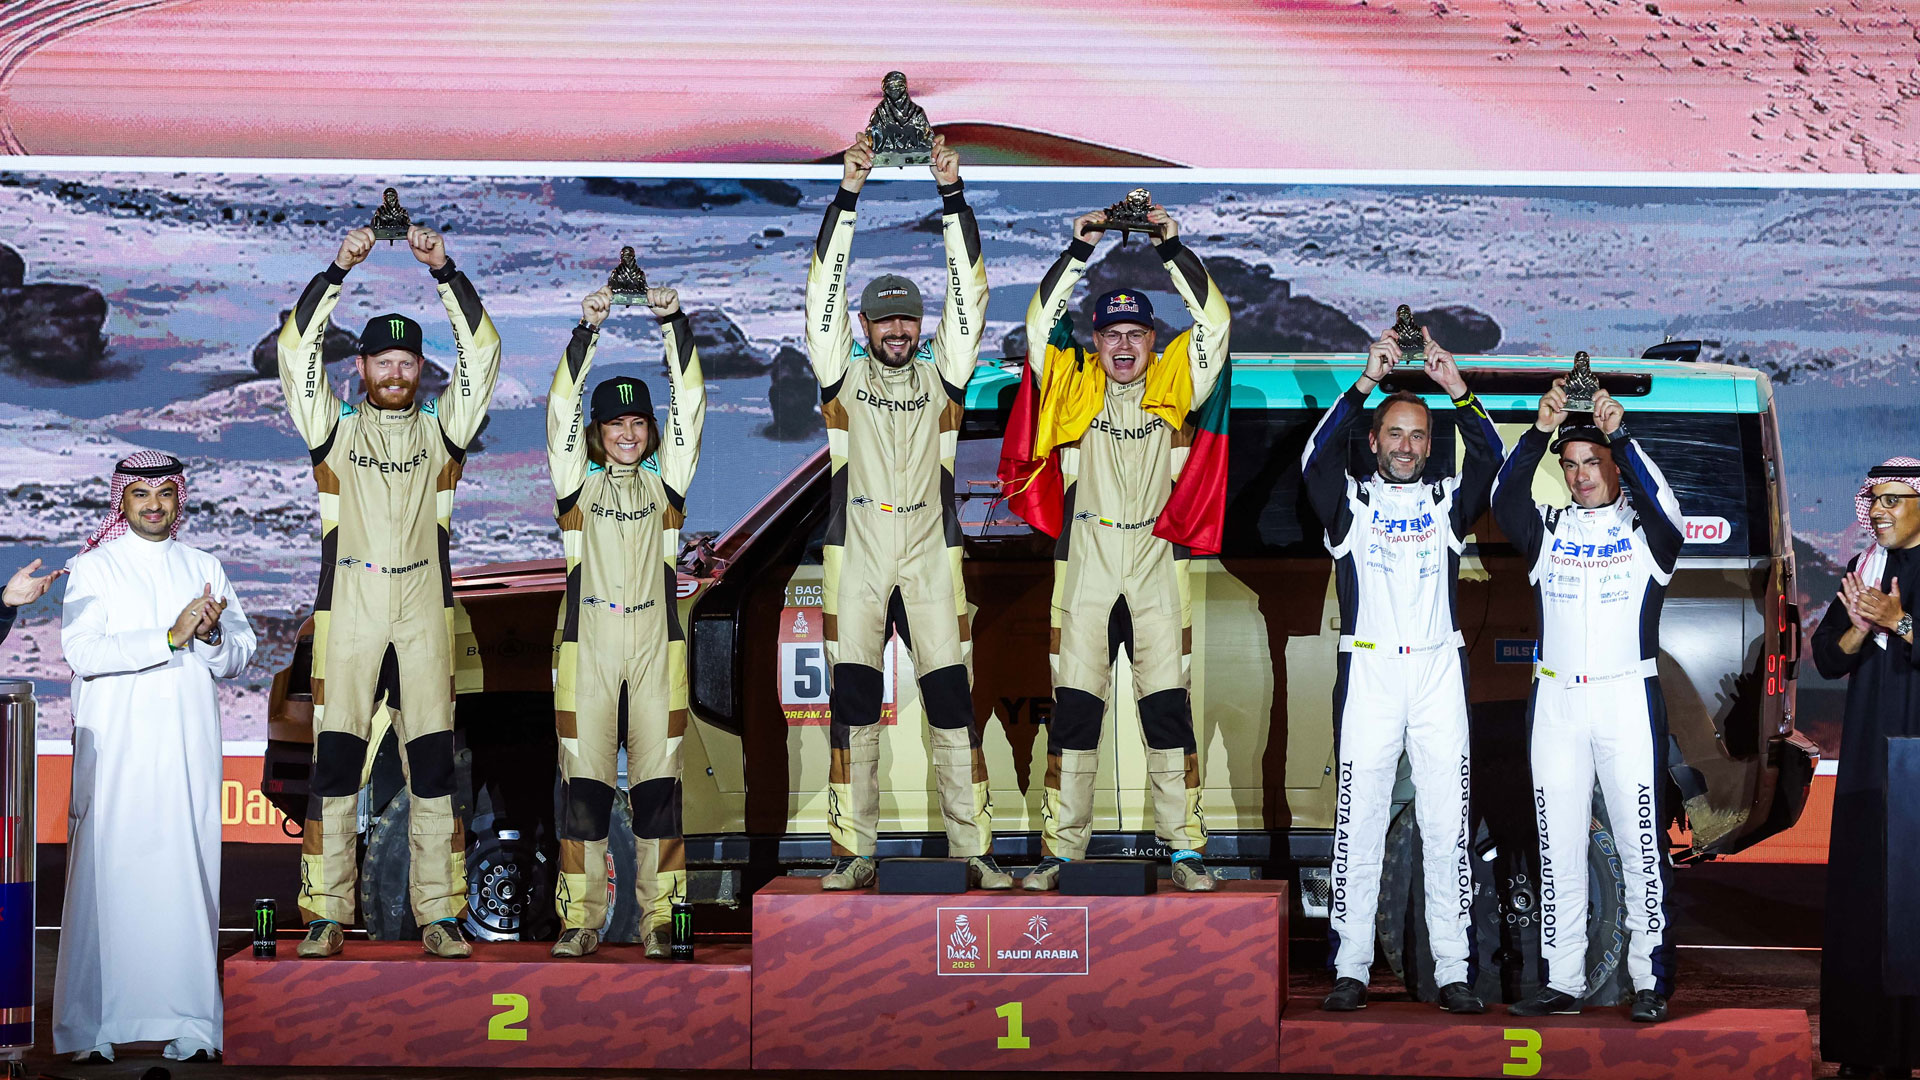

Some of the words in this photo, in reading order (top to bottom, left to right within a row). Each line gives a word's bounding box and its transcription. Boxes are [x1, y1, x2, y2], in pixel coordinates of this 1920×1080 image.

[820, 253, 845, 332] DEFENDER
[949, 257, 969, 335] DEFENDER
[1107, 305, 1121, 313] Red
[1123, 303, 1139, 312] Bull
[857, 389, 931, 411] DEFENDER
[1090, 418, 1164, 440] DEFENDER
[349, 448, 429, 473] DEFENDER
[590, 502, 656, 521] DEFENDER
[897, 501, 927, 513] O.VIDAL
[1686, 521, 1723, 539] trol
[391, 558, 428, 574] BERRIMAN
[625, 599, 655, 614] S.PRICE
[795, 596, 823, 605] VIDA
[1338, 760, 1353, 825] TOYOTA
[1460, 754, 1469, 801] BODY
[1535, 786, 1549, 851] TOYOTA
[1637, 783, 1650, 829] BODY
[1122, 848, 1168, 857] SHACKL
[1336, 829, 1349, 874] AUTO
[1640, 833, 1655, 875] AUTO
[1335, 877, 1347, 923] BODY
[1541, 858, 1556, 901] AUTO
[1544, 903, 1557, 948] BODY
[947, 945, 980, 960] DAKAR
[997, 950, 1031, 959] SAUDI
[1035, 950, 1078, 959] ARABIA
[488, 994, 529, 1041] 2
[995, 1002, 1030, 1048] 1
[1503, 1028, 1542, 1076] 3
